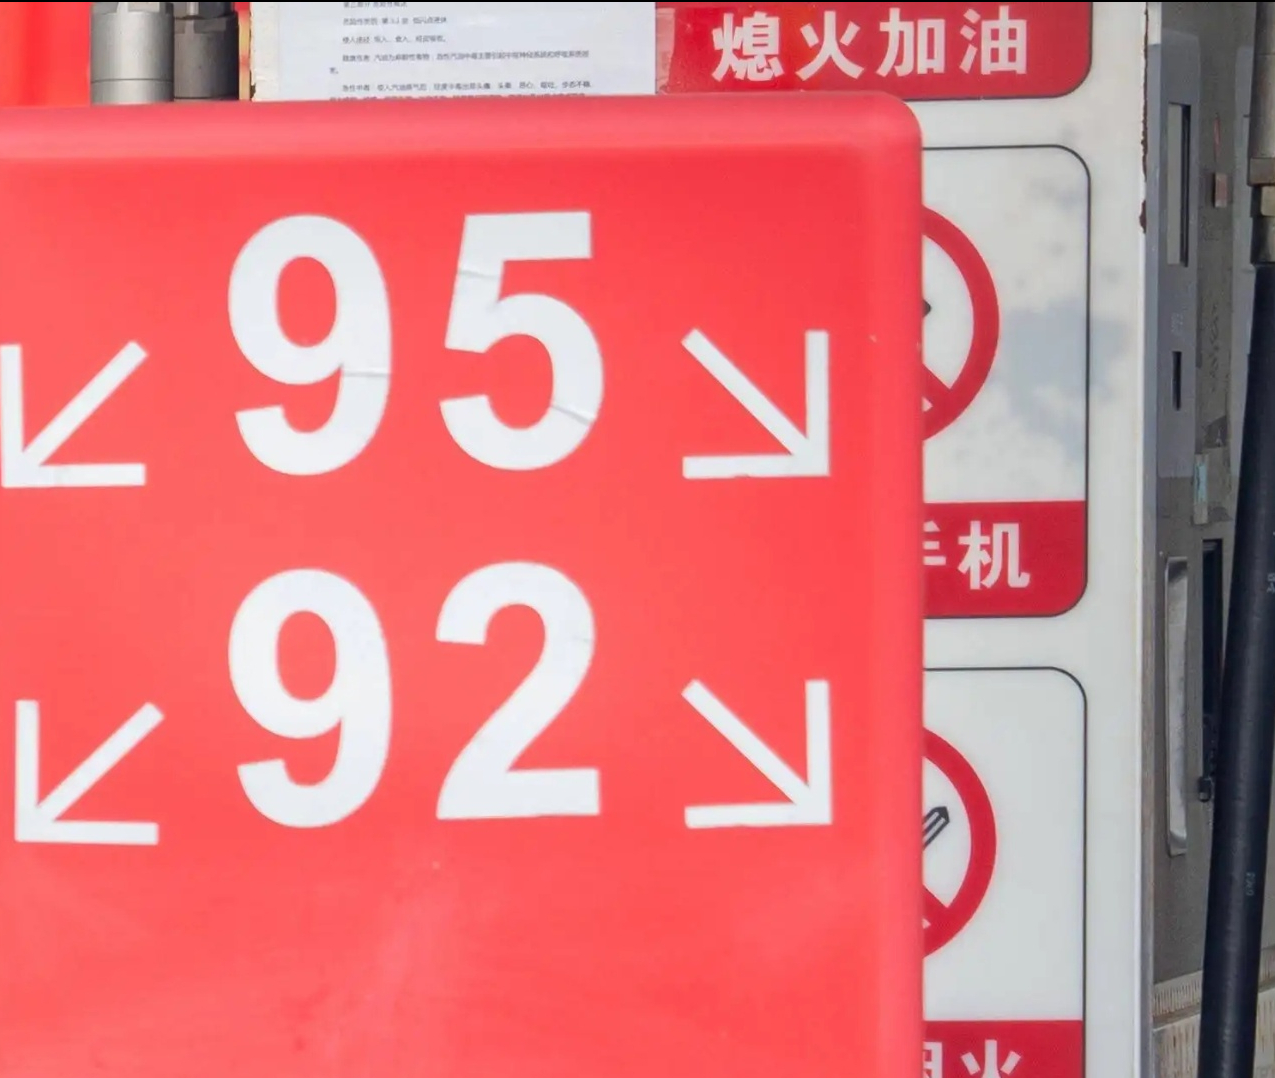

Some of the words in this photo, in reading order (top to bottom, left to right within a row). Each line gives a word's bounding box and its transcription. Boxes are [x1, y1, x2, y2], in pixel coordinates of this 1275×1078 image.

[711, 5, 1028, 82] 熄火加油
[227, 210, 604, 476] 95
[227, 561, 600, 828] 92
